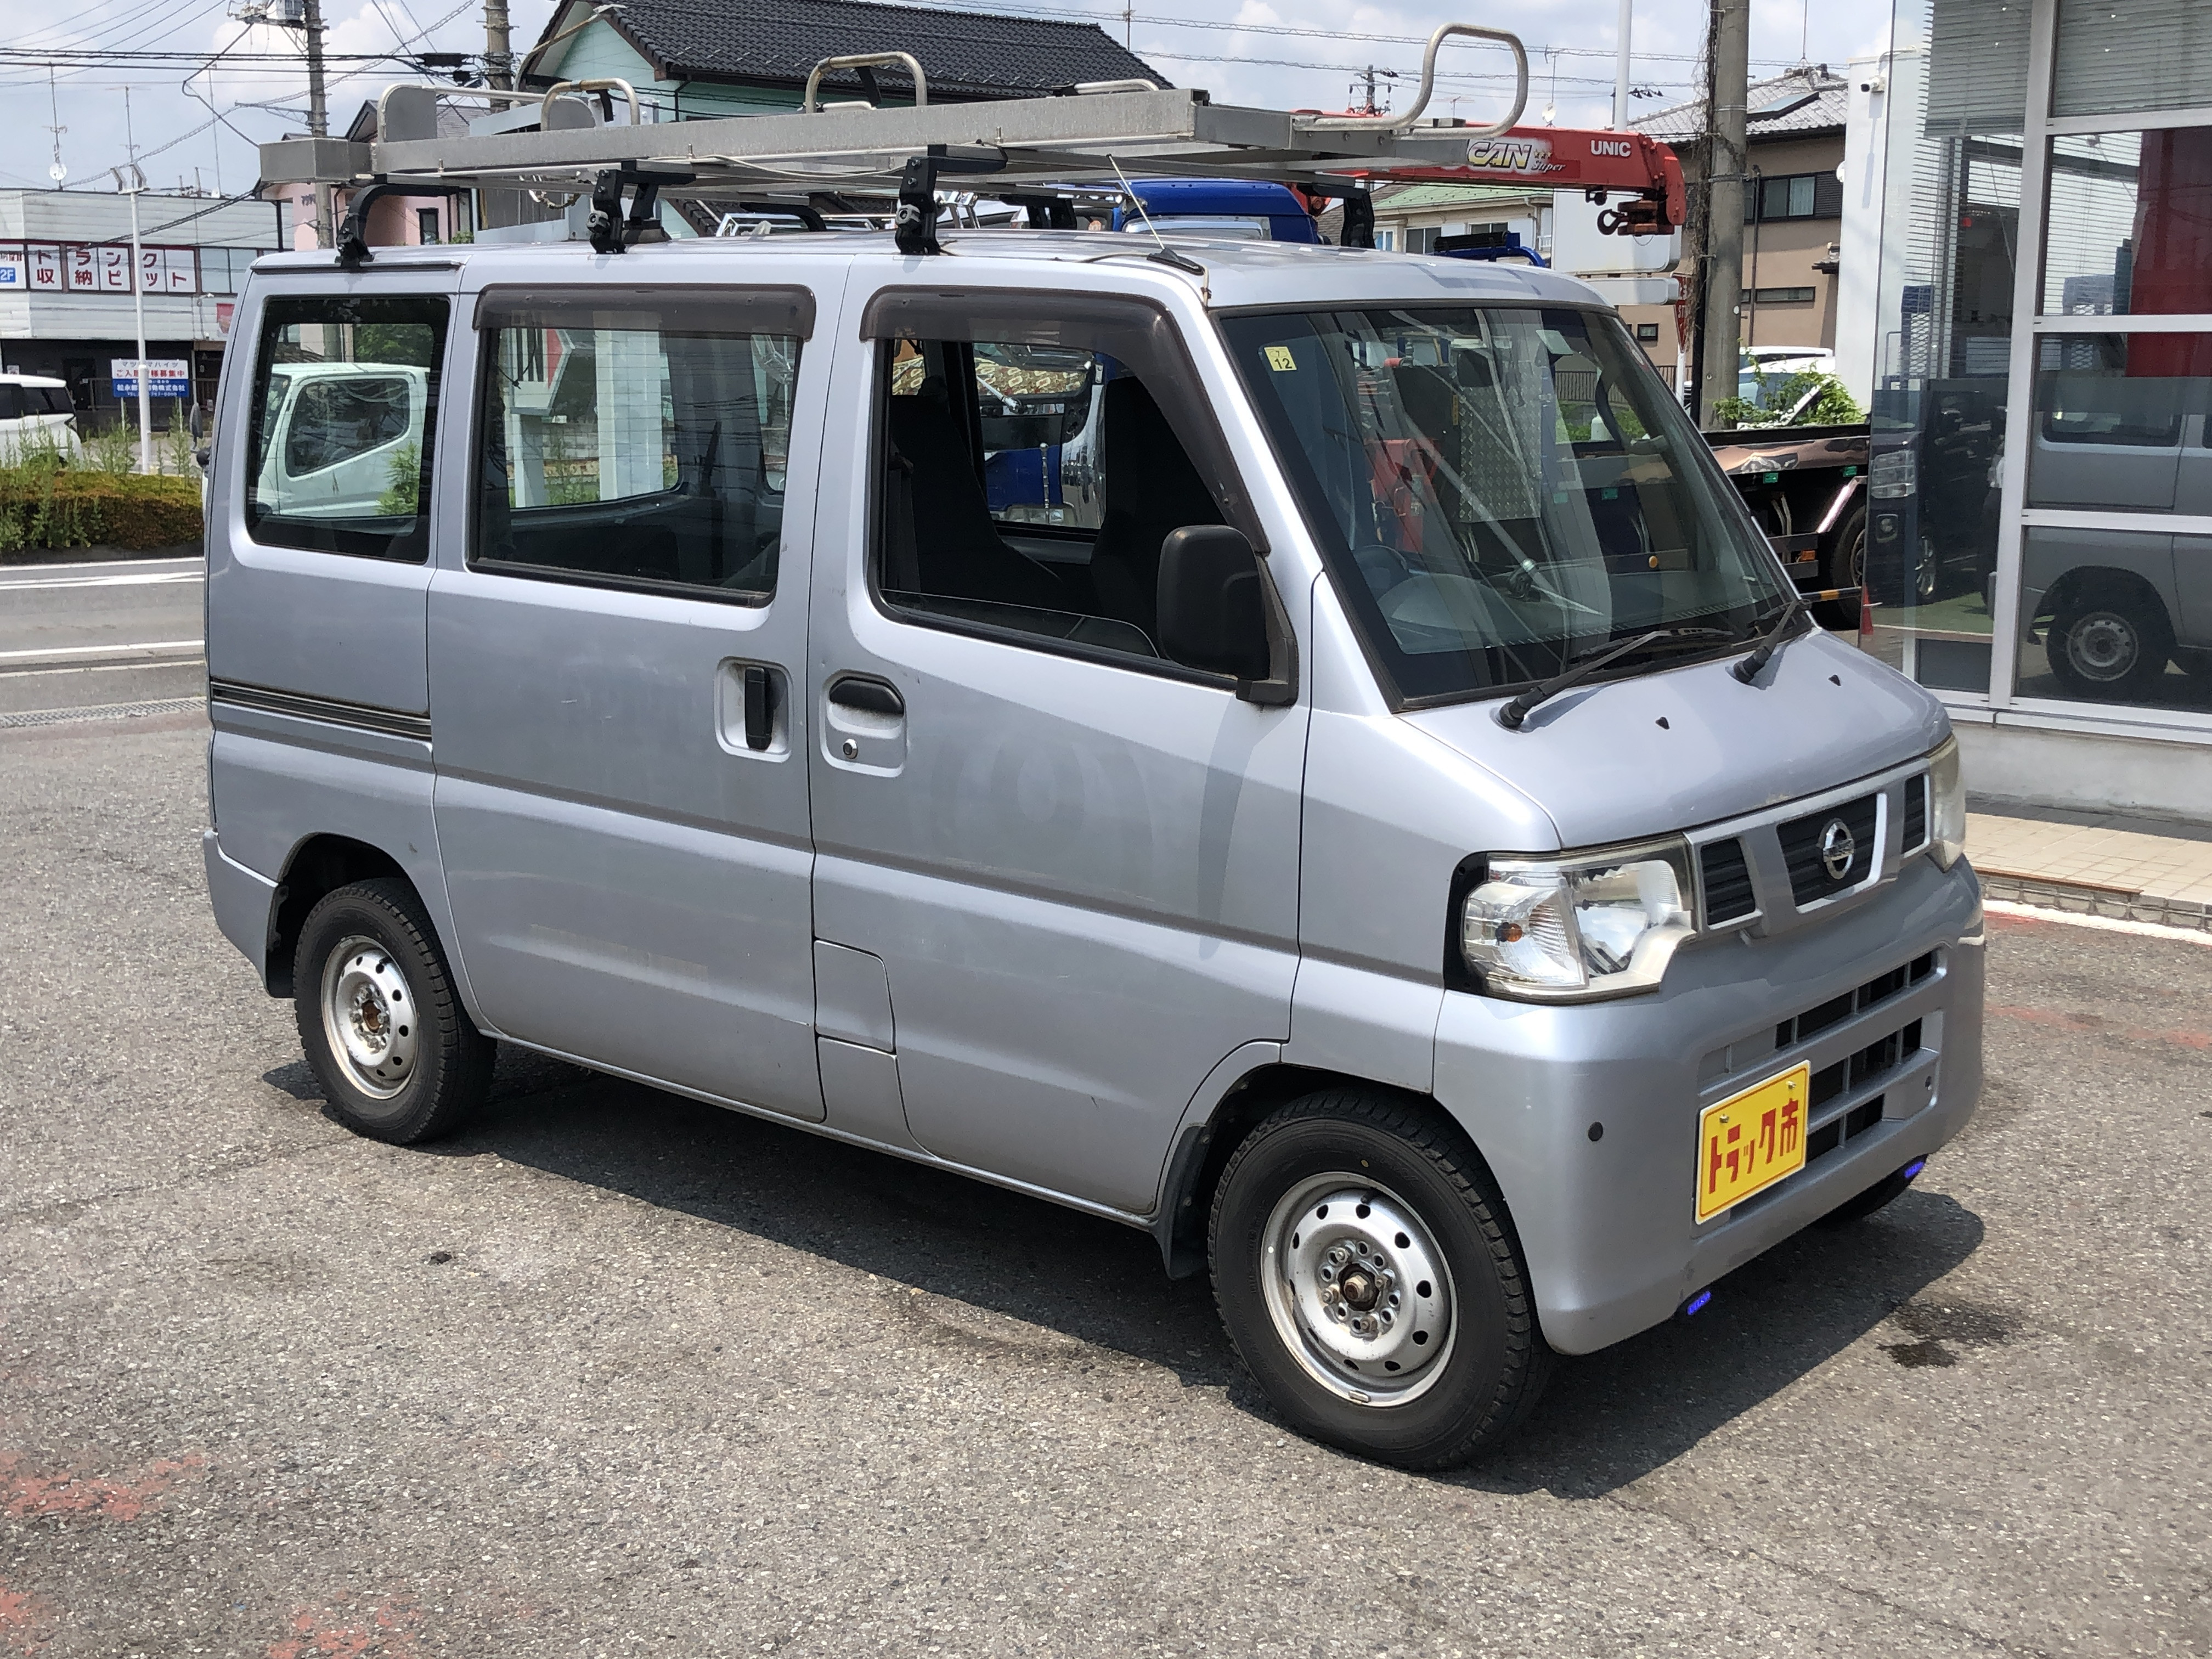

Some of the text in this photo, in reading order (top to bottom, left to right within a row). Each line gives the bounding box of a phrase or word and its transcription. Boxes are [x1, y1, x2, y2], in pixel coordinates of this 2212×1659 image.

[1468, 141, 1532, 170] CAN
[1590, 139, 1631, 157] UNIC
[1531, 160, 1566, 173] Super
[37, 250, 157, 267] トランク
[0, 269, 14, 281] 2F
[37, 268, 187, 286] 収納ピット
[1274, 358, 1293, 369] 12
[1708, 1098, 1798, 1194] トラック市
